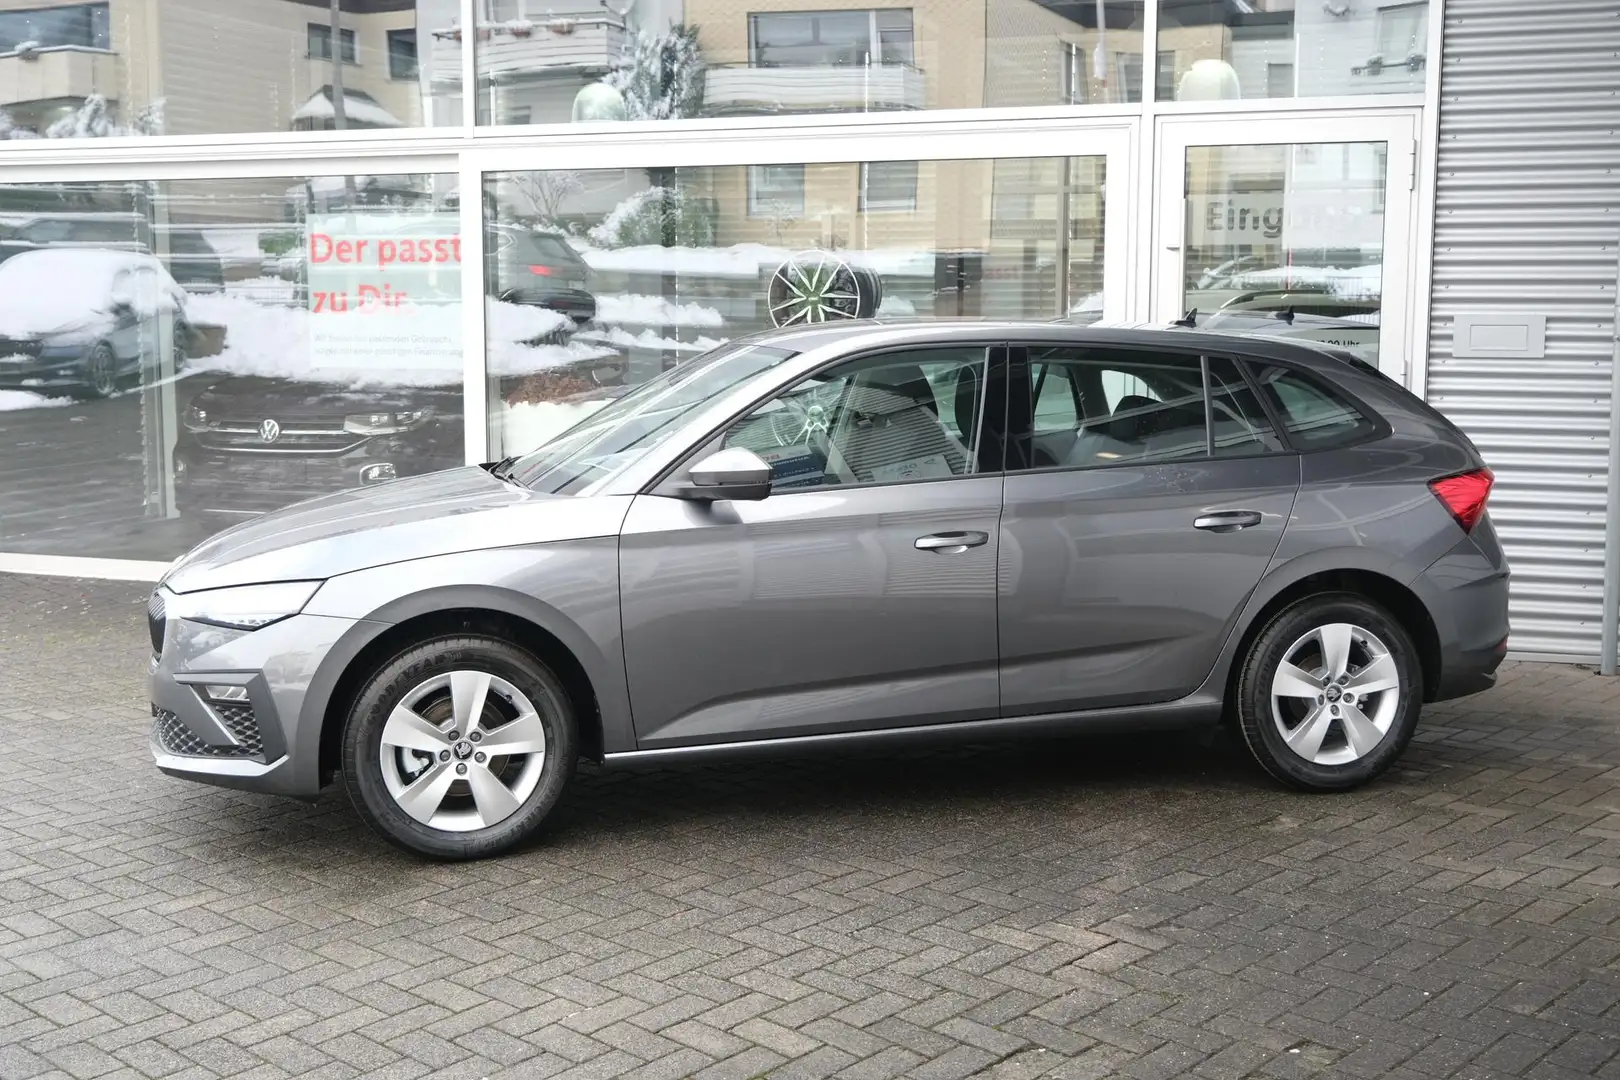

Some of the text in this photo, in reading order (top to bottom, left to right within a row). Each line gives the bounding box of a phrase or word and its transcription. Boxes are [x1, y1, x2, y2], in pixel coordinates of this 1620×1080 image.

[310, 233, 461, 271] Der passt
[313, 291, 347, 313] zu
